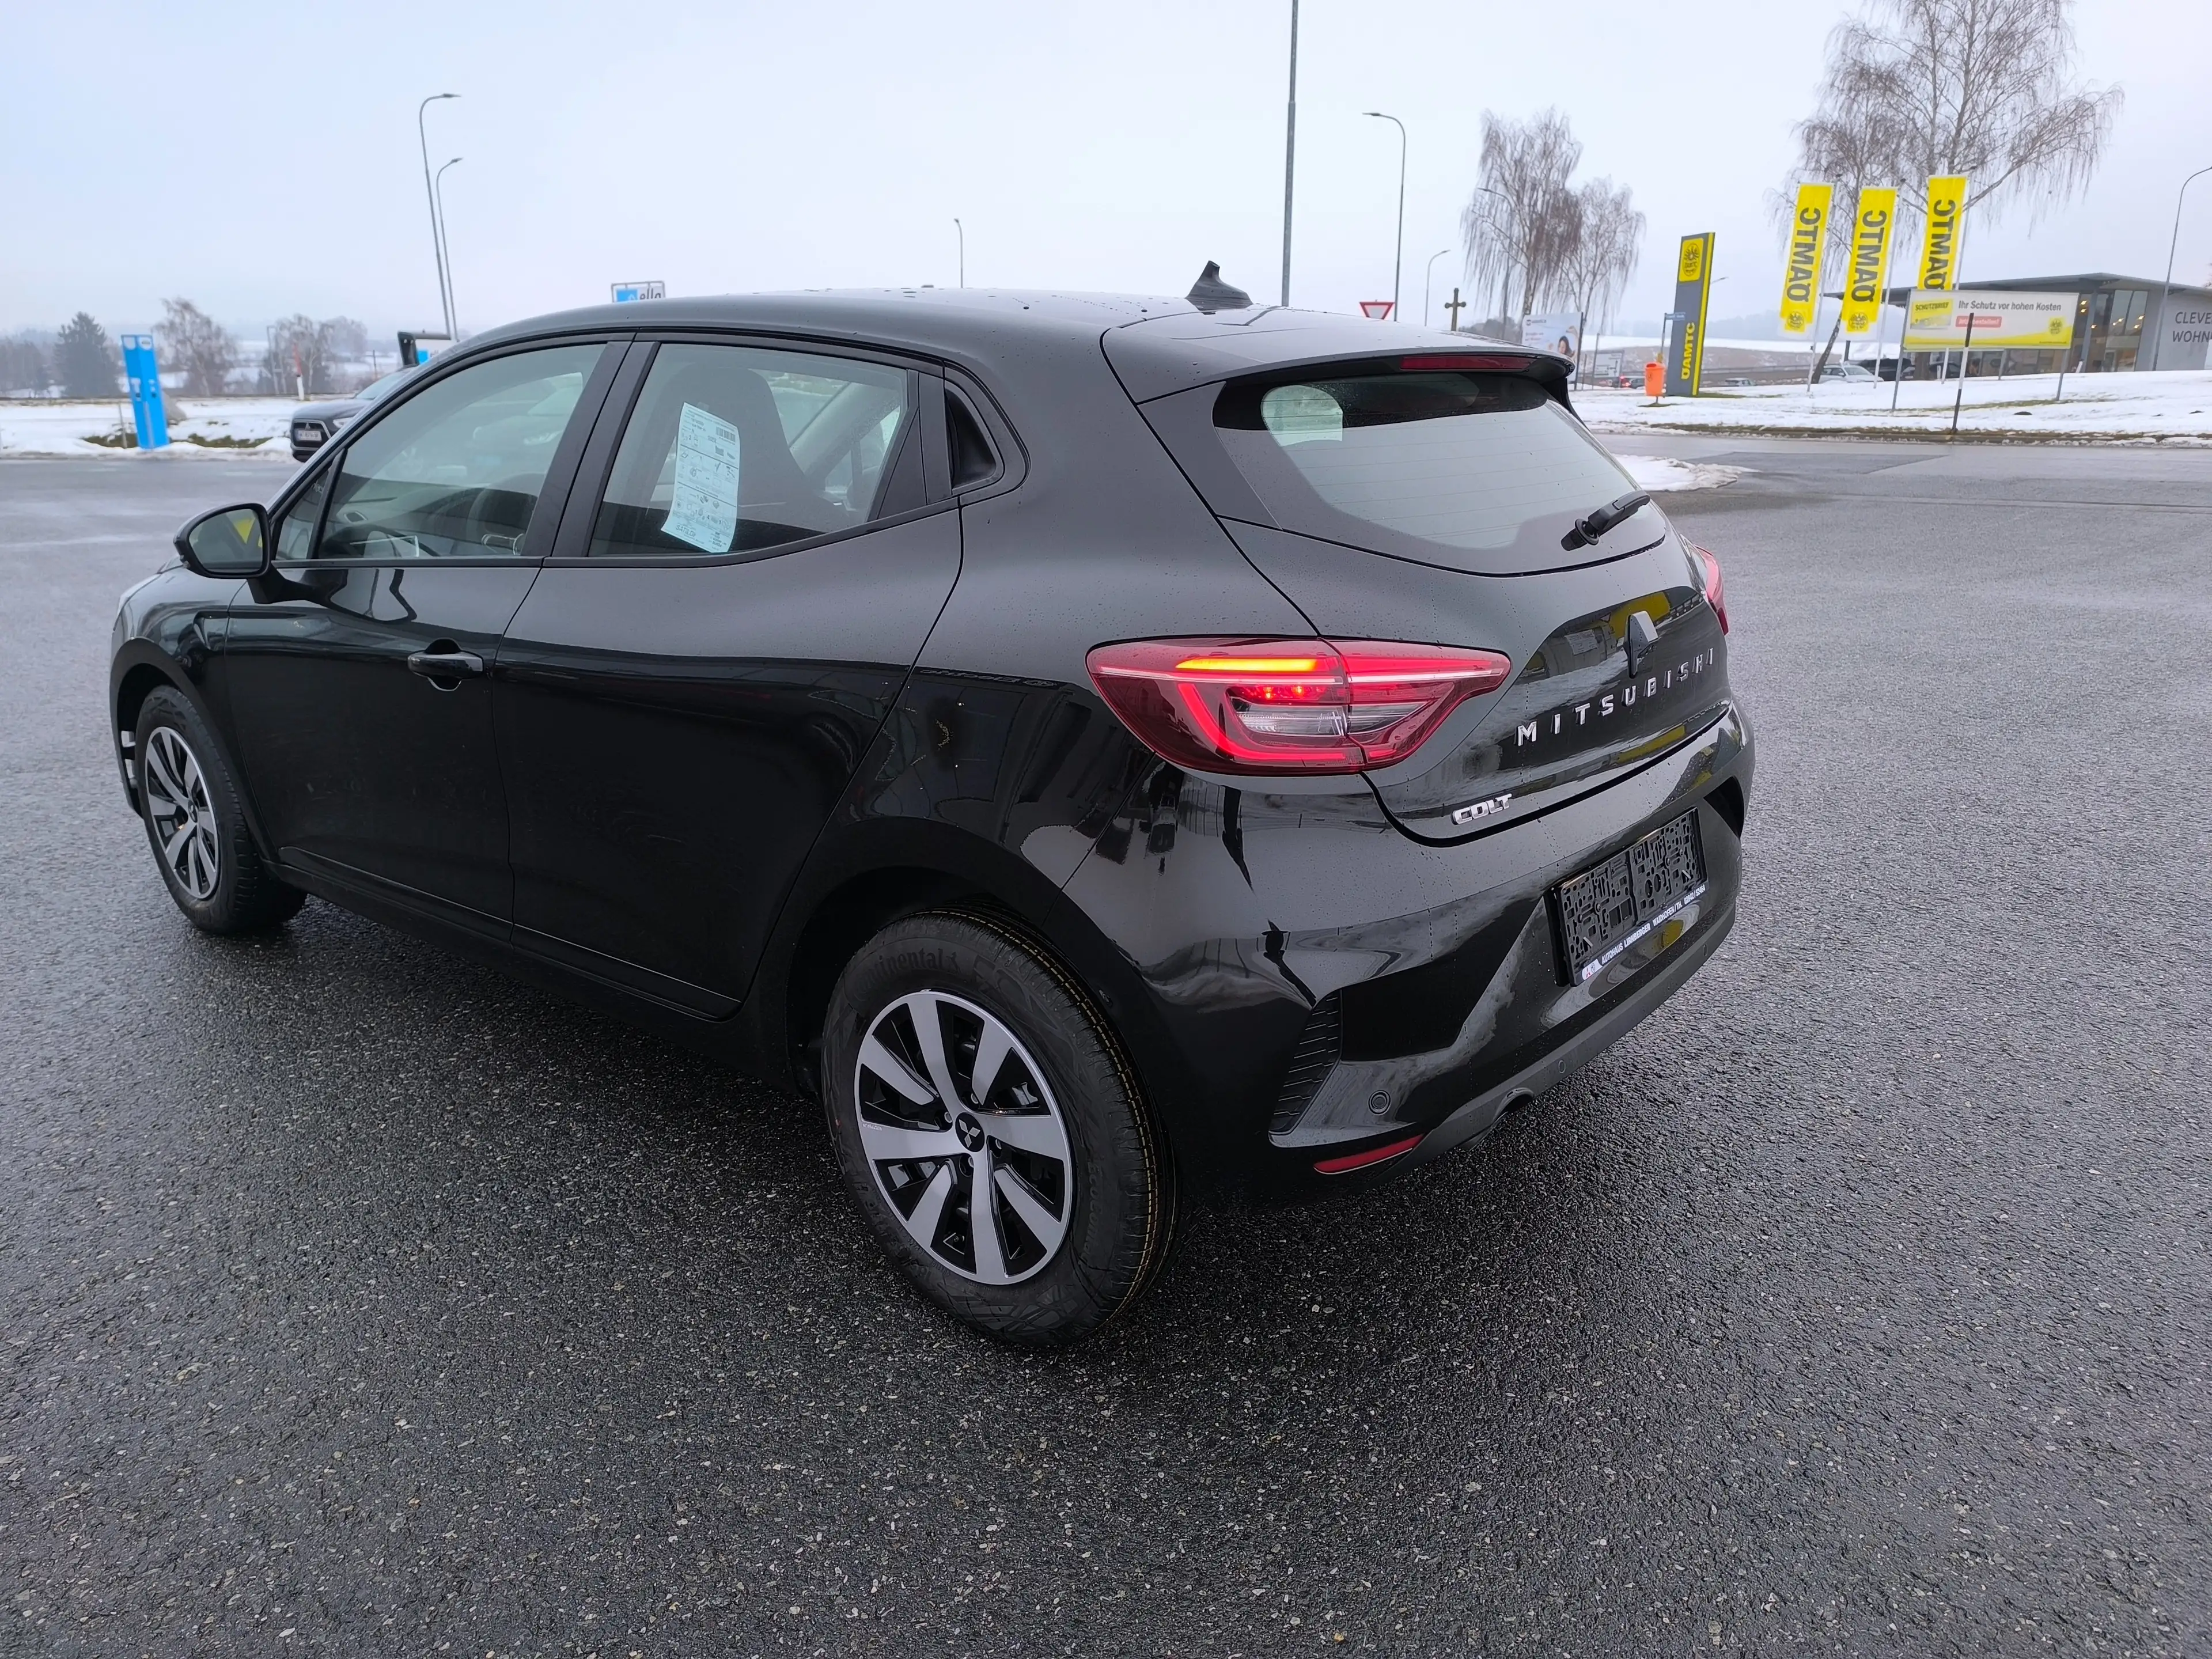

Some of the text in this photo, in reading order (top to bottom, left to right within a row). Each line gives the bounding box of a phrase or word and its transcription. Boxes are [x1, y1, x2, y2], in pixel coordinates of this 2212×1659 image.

[1959, 300, 2062, 311] Ihr Schutz vor hohen Kosten
[2175, 311, 2212, 324] CLEVE
[2172, 330, 2212, 343] WOHN
[1514, 648, 1714, 747] MITSUBISHI
[1451, 793, 1512, 825] COLT
[1601, 942, 1623, 965] AUTOHAUS
